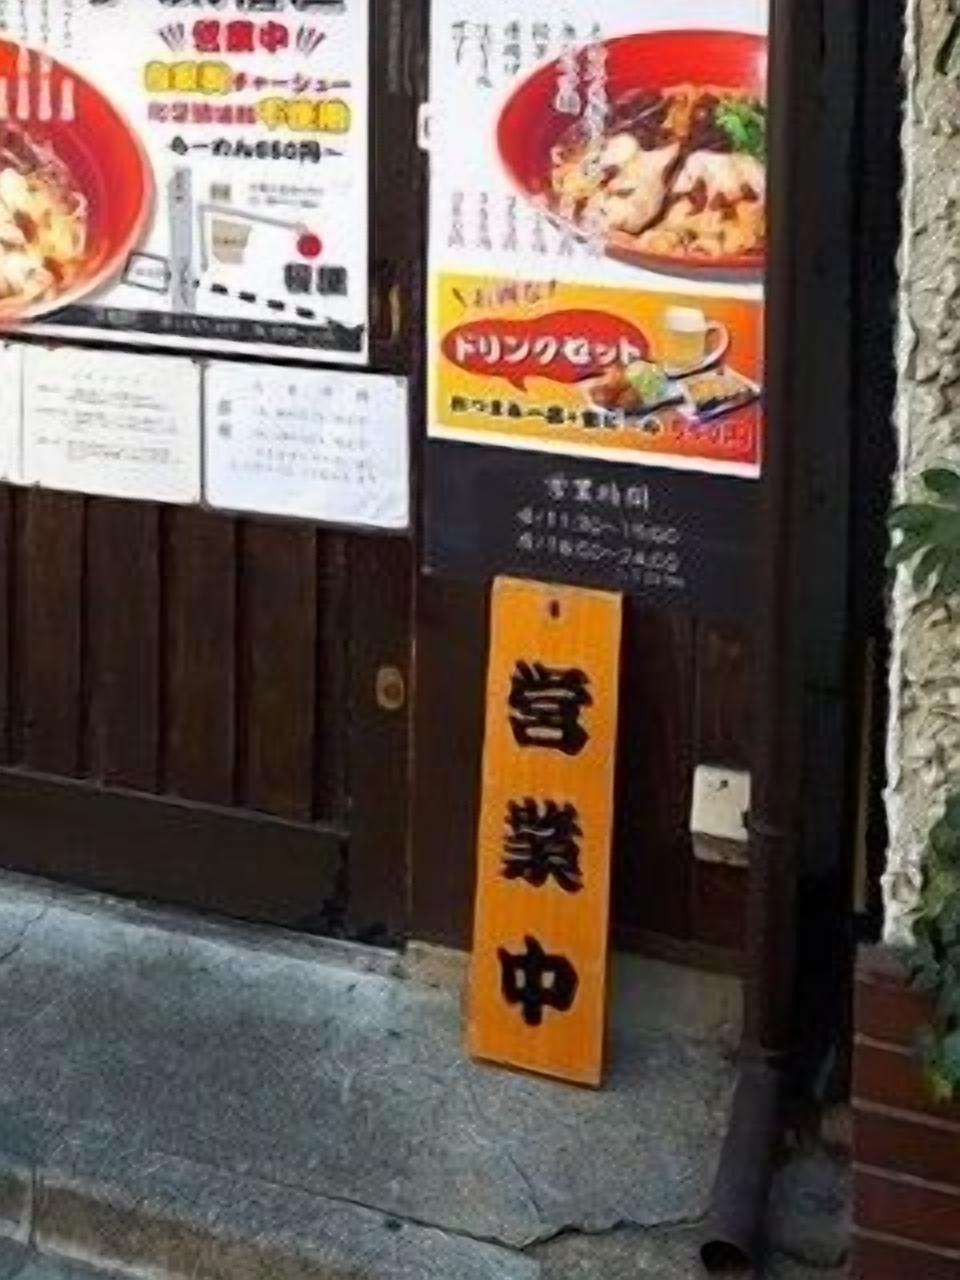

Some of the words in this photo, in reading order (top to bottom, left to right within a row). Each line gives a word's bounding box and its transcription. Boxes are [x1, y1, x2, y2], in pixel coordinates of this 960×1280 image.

[453, 333, 642, 366] ドリンクセット
[497, 659, 593, 1028] 営業中
